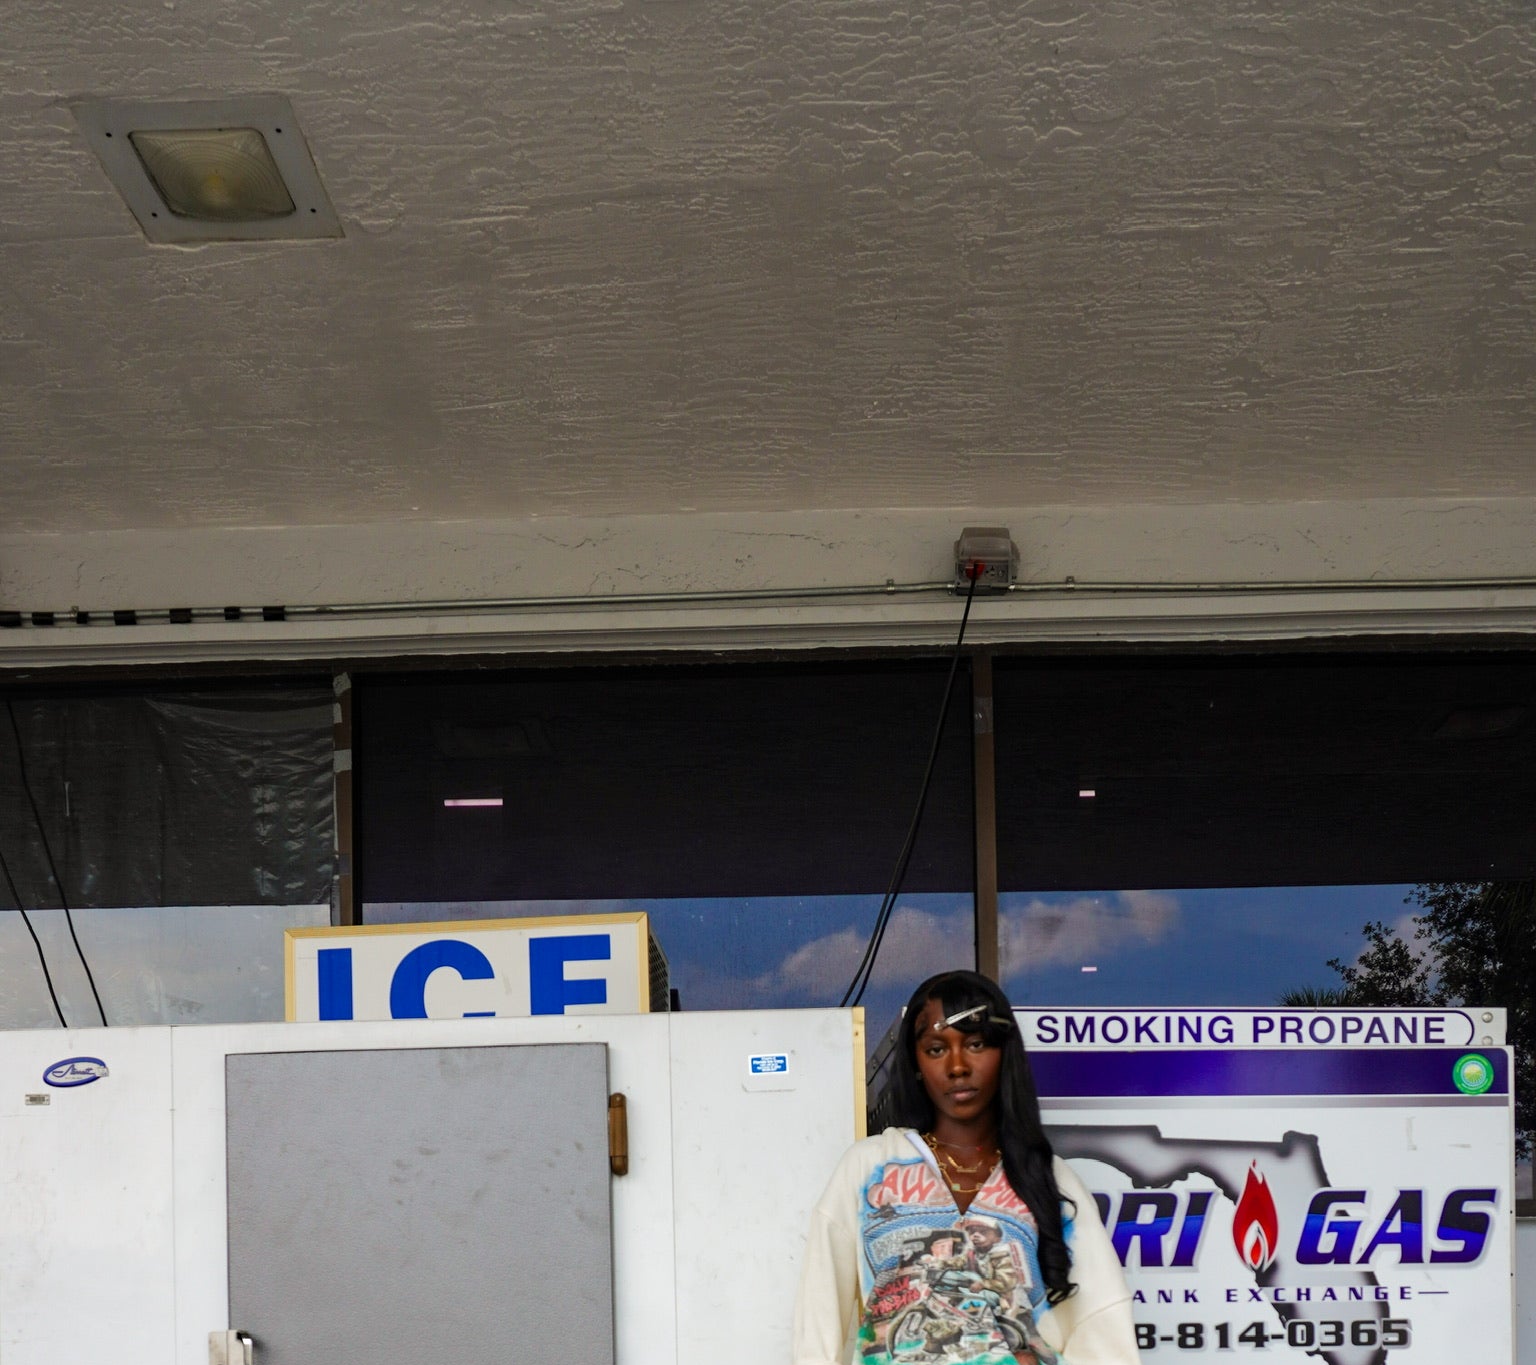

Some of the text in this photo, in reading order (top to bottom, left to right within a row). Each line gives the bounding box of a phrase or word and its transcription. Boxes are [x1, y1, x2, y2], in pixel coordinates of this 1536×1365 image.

[318, 934, 611, 1021] ICE
[1036, 1015, 1446, 1044] SMOKING PROPANE
[1092, 1191, 1214, 1267] RI
[1296, 1188, 1497, 1265] GAS
[1133, 1286, 1412, 1304] ANK EXCHANGE
[1134, 1318, 1410, 1350] 8-814-0365
